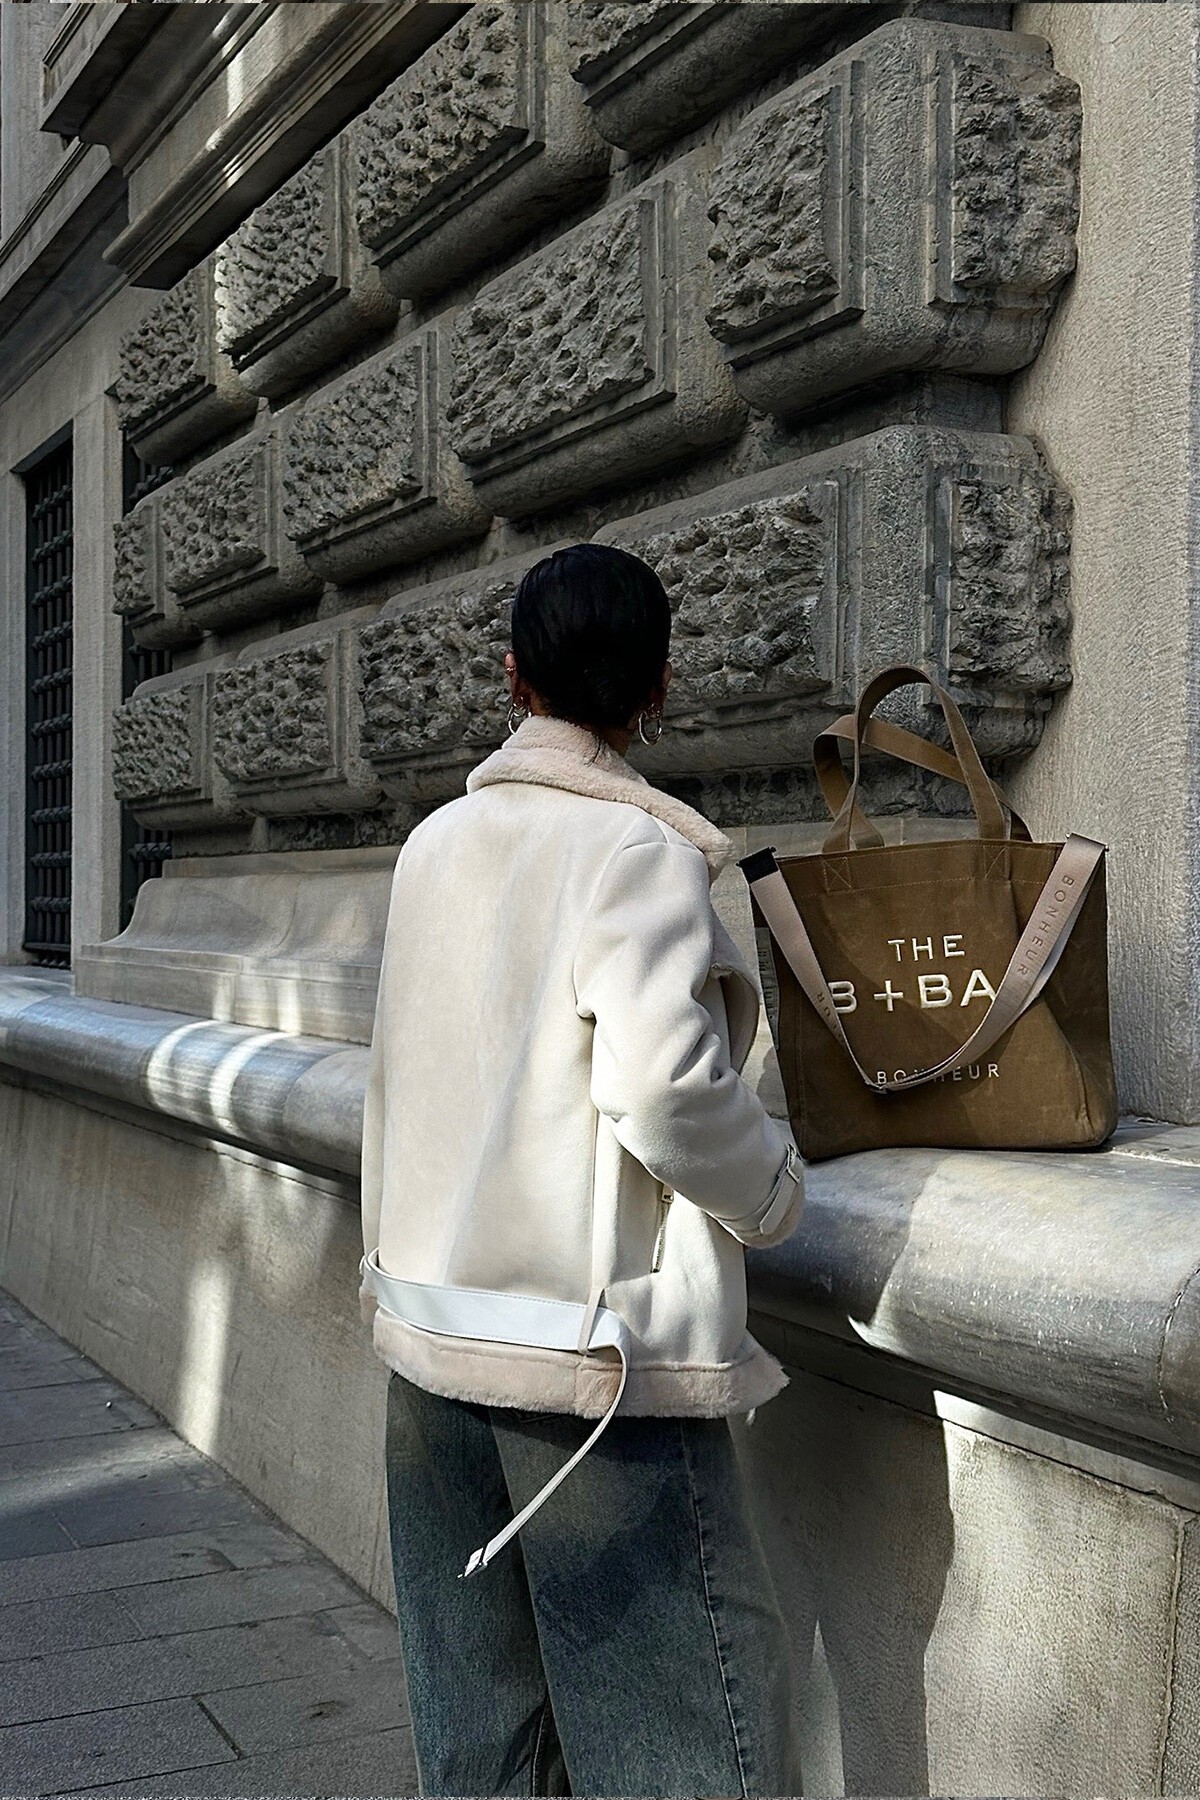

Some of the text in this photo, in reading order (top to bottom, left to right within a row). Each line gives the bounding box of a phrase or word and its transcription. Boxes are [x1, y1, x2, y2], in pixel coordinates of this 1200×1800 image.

[1017, 875, 1075, 976] BONHEUR
[887, 934, 965, 962] THE
[876, 1063, 1000, 1085] BOEUR
